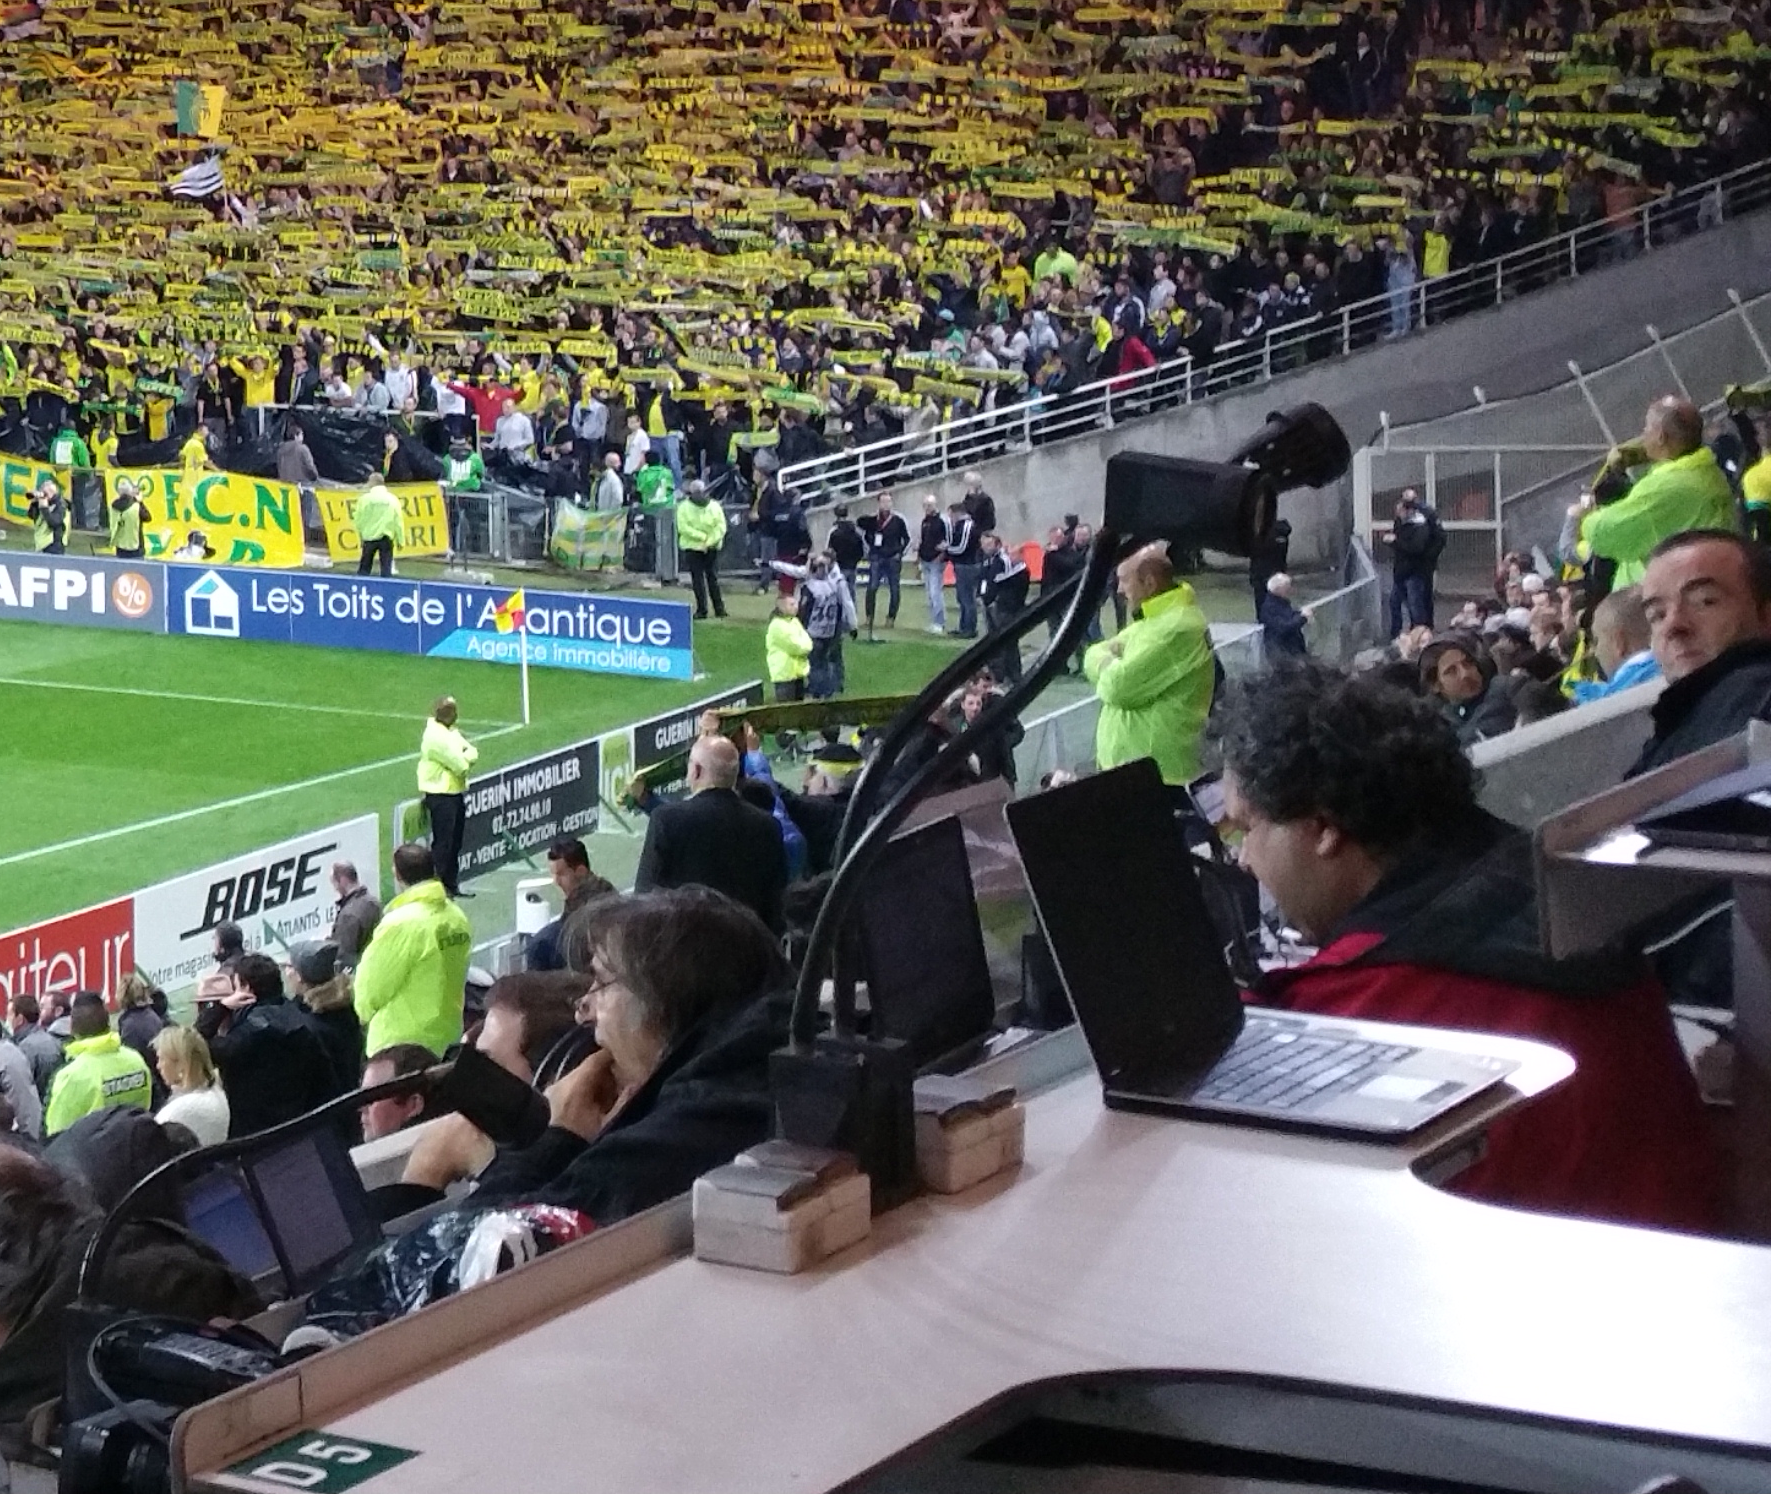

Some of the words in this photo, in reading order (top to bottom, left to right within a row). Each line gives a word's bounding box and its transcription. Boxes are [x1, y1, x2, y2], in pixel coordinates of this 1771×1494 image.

[251, 578, 305, 615] Les
[313, 583, 386, 622] Toits
[394, 589, 445, 626] de
[552, 642, 672, 674] immobilière
[463, 780, 512, 818] GUERIN
[513, 757, 581, 801] IMMOBILIER
[178, 842, 339, 942] BOSE
